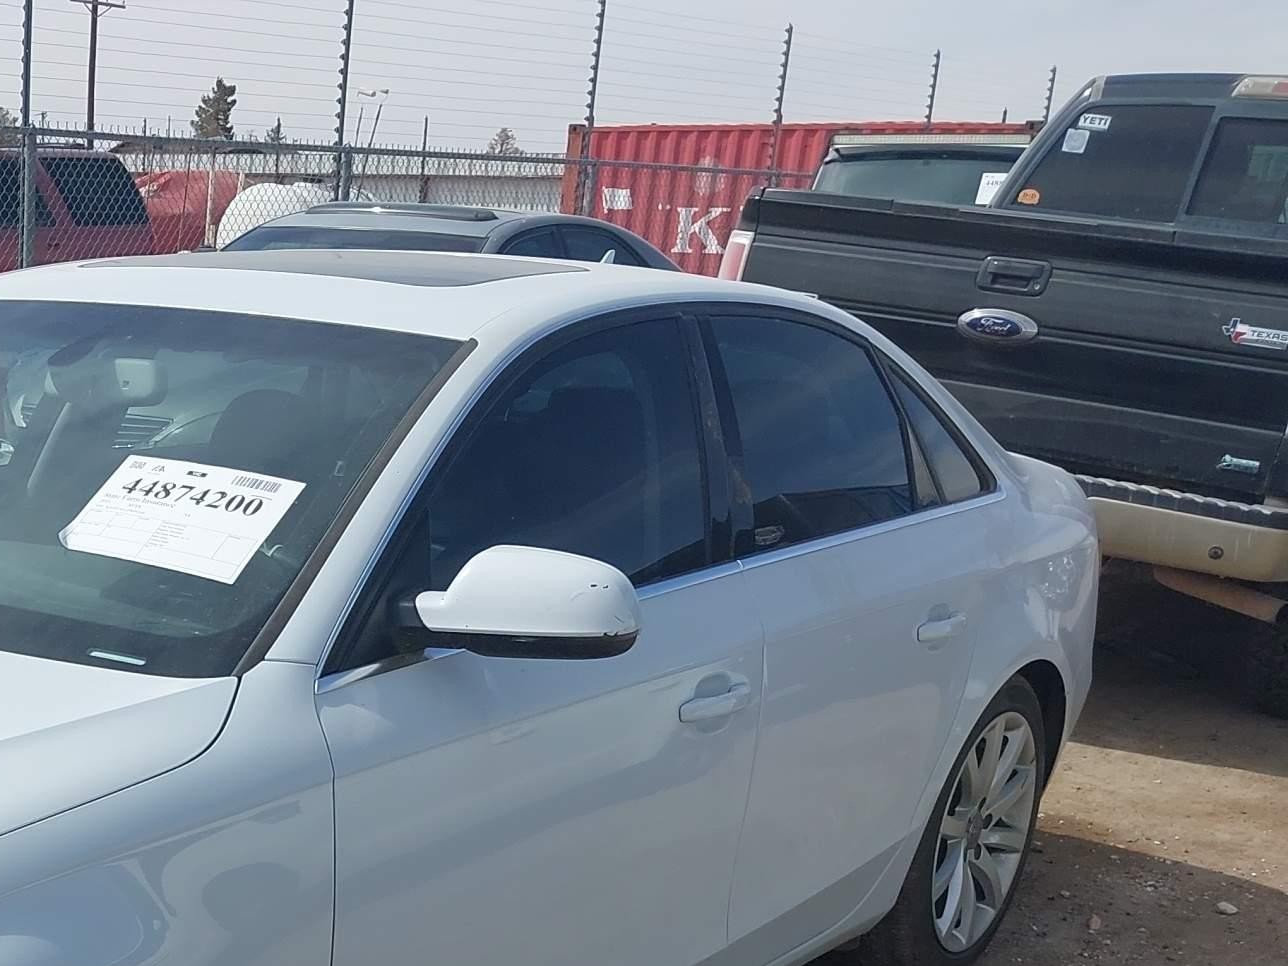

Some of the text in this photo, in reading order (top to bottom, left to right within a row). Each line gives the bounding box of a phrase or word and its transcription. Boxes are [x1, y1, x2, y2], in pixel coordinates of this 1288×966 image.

[1083, 115, 1109, 128] YETI
[979, 317, 1012, 331] Ford
[1250, 329, 1288, 341] TEXAS
[122, 478, 264, 516] 44874200
